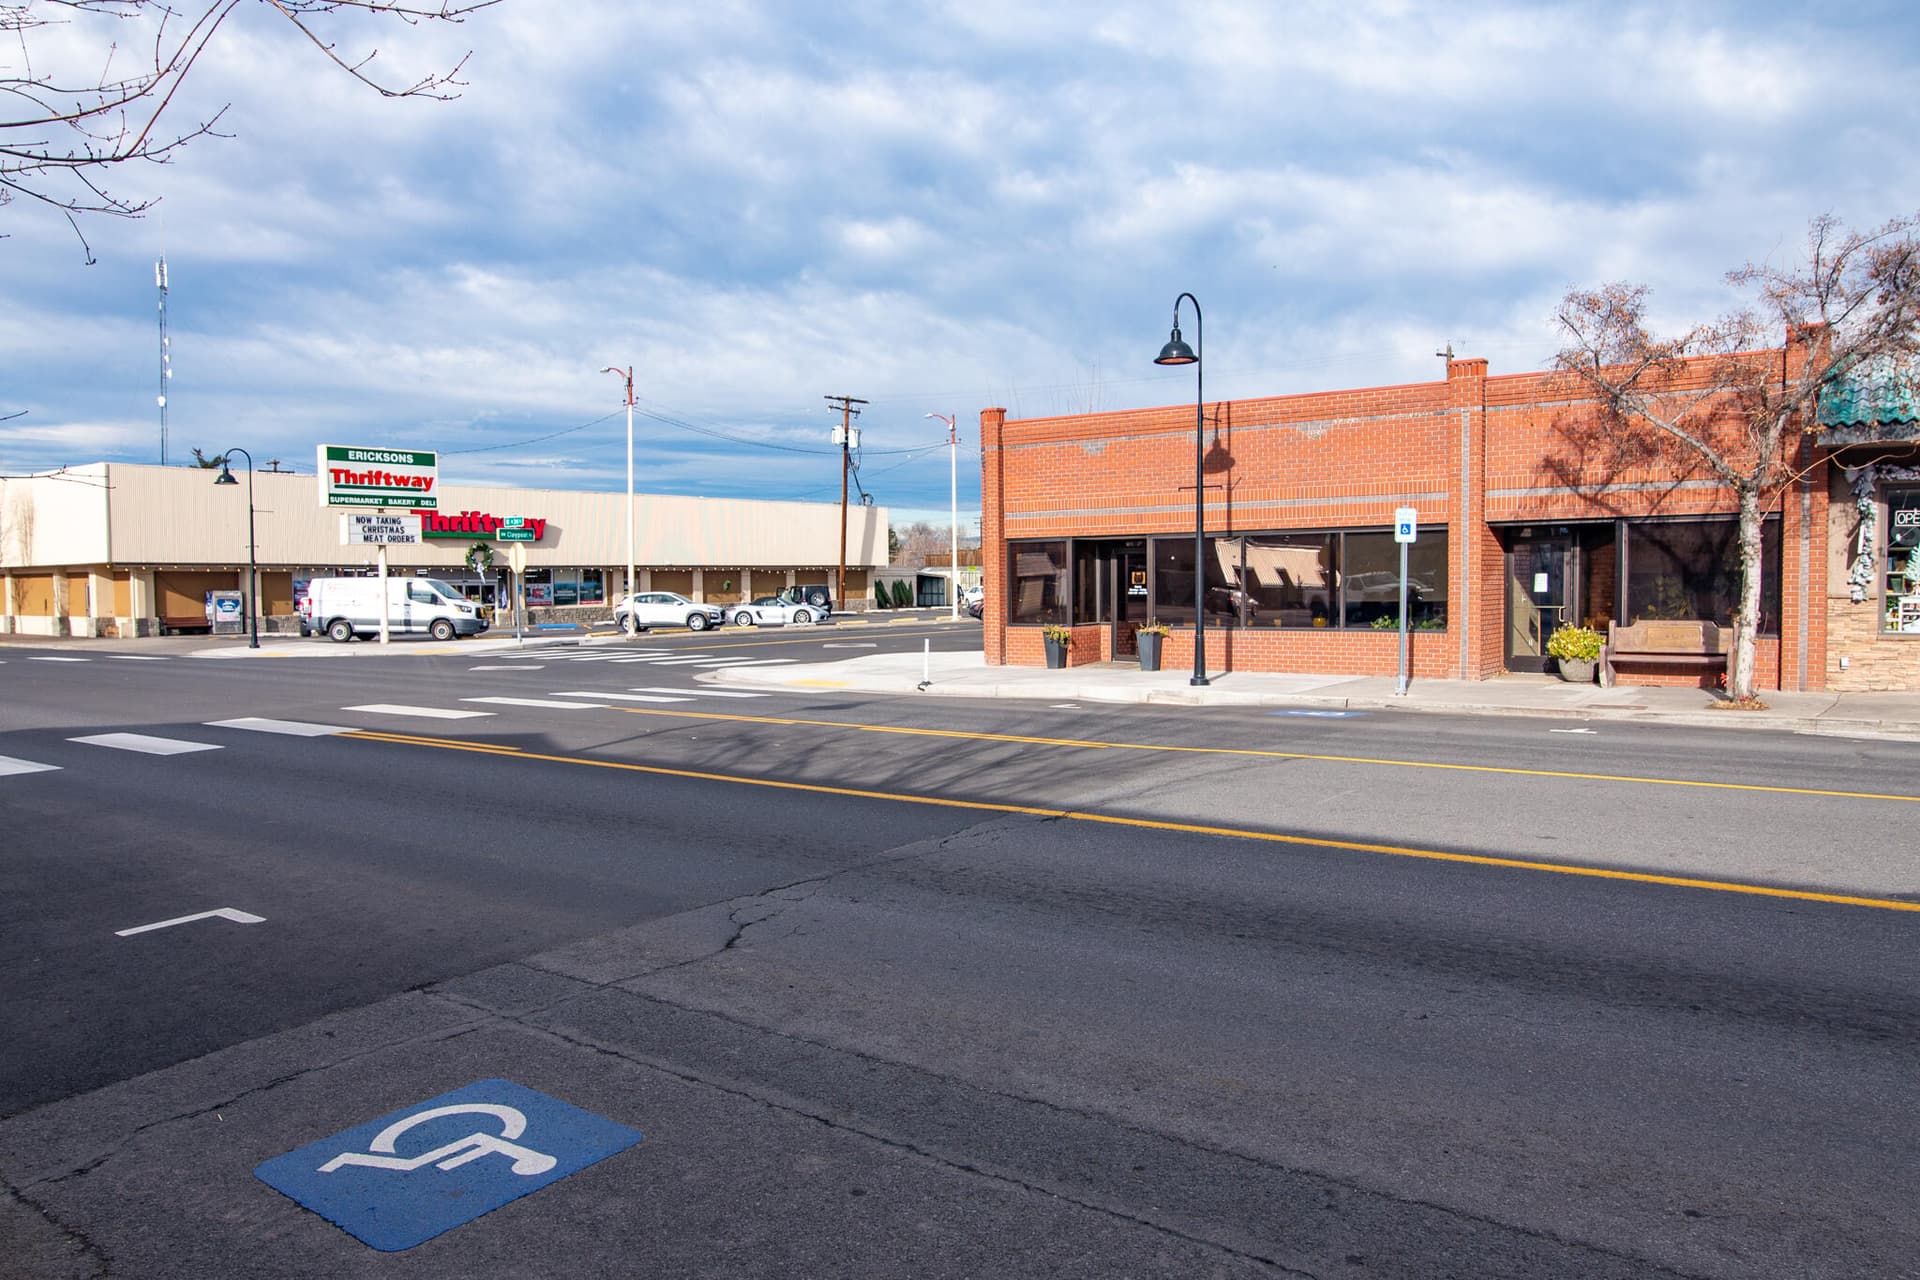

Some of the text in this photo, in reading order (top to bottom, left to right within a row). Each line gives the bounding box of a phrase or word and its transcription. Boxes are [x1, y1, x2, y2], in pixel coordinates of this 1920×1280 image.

[348, 450, 414, 463] ERICKSONS
[329, 468, 434, 492] Thriftway
[330, 496, 383, 505] SUPERMARKET
[388, 498, 416, 506] BAKERY
[355, 516, 402, 525] NOW TAKING
[411, 509, 546, 541] Thrifty
[362, 525, 405, 534] CHRISTMAS
[363, 534, 415, 543] MEAT ORDERS
